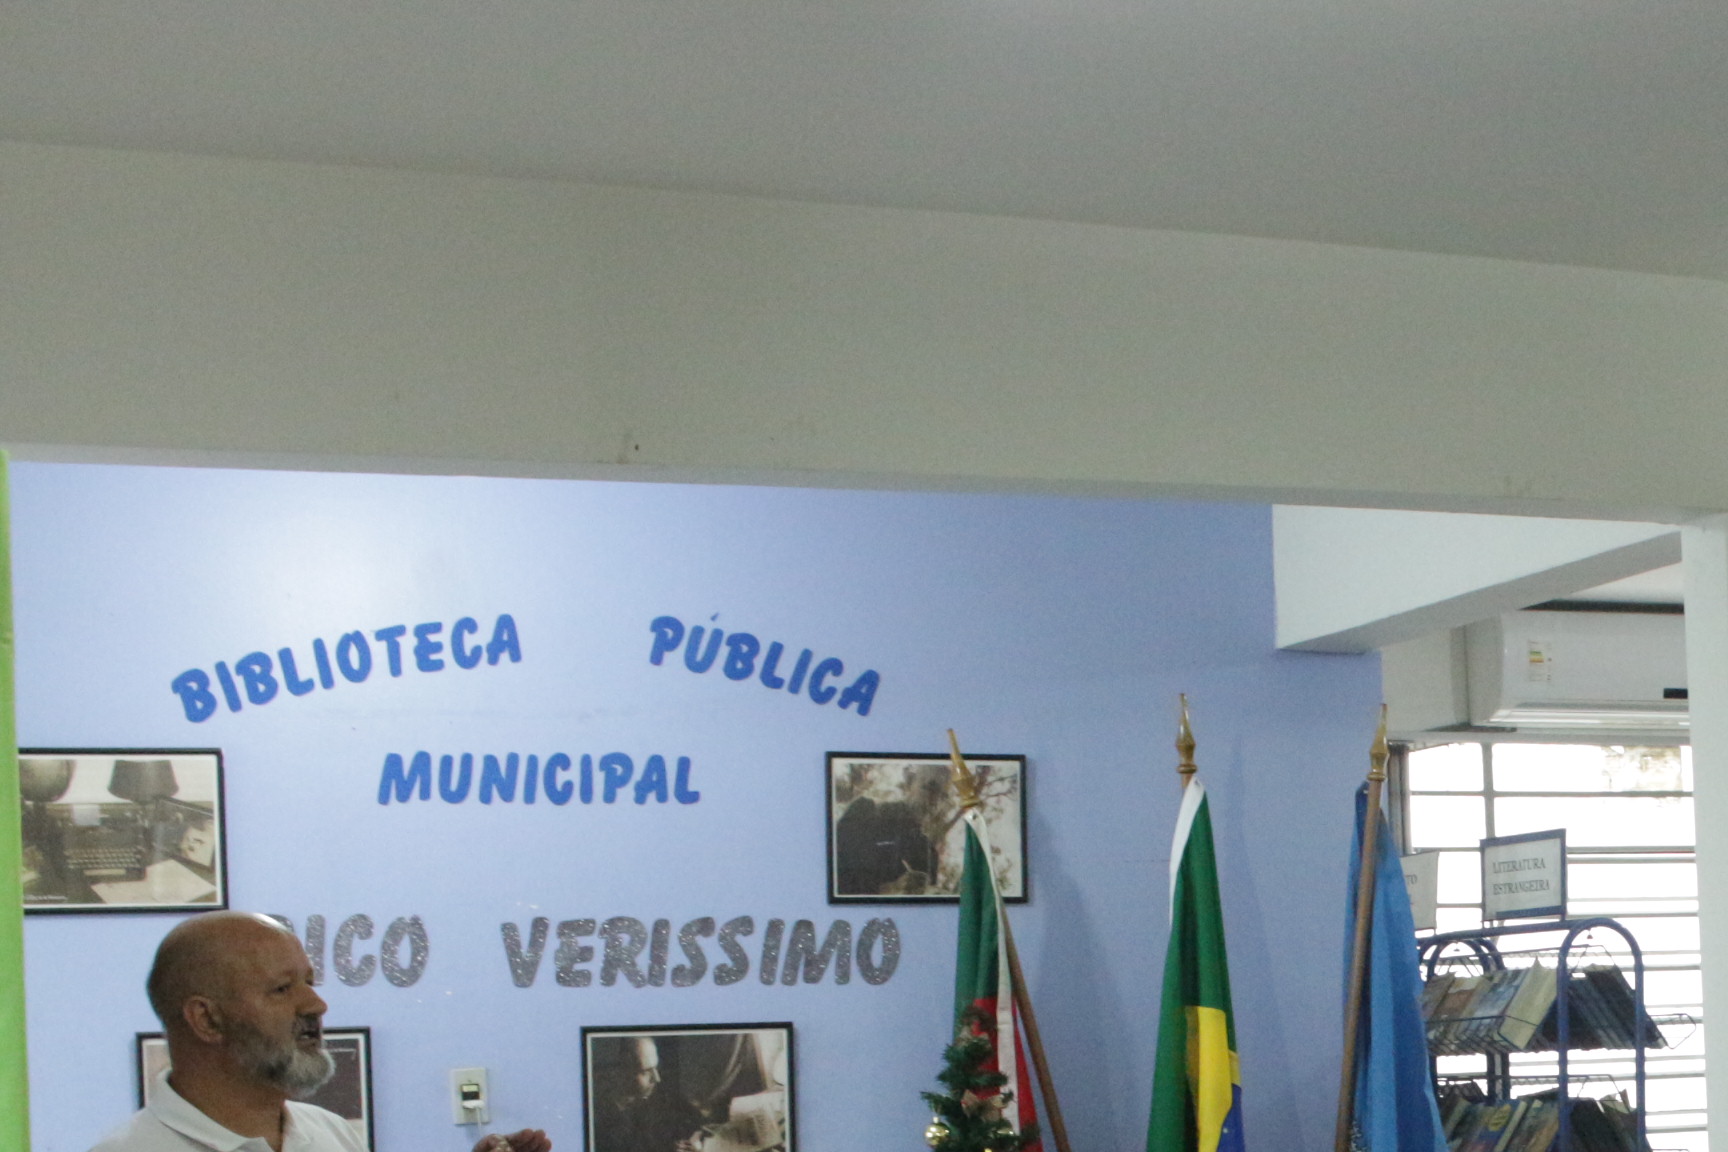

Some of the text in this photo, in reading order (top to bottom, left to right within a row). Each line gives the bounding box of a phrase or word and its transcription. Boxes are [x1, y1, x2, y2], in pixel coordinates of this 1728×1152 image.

[171, 612, 880, 723] BIBLIOTECA PÚBLICA
[377, 751, 700, 806] MUNICIPAL
[1492, 857, 1547, 874] LITERATURA
[1492, 879, 1551, 896] ESTRANGEIRA
[500, 915, 901, 989] VERISSIMO
